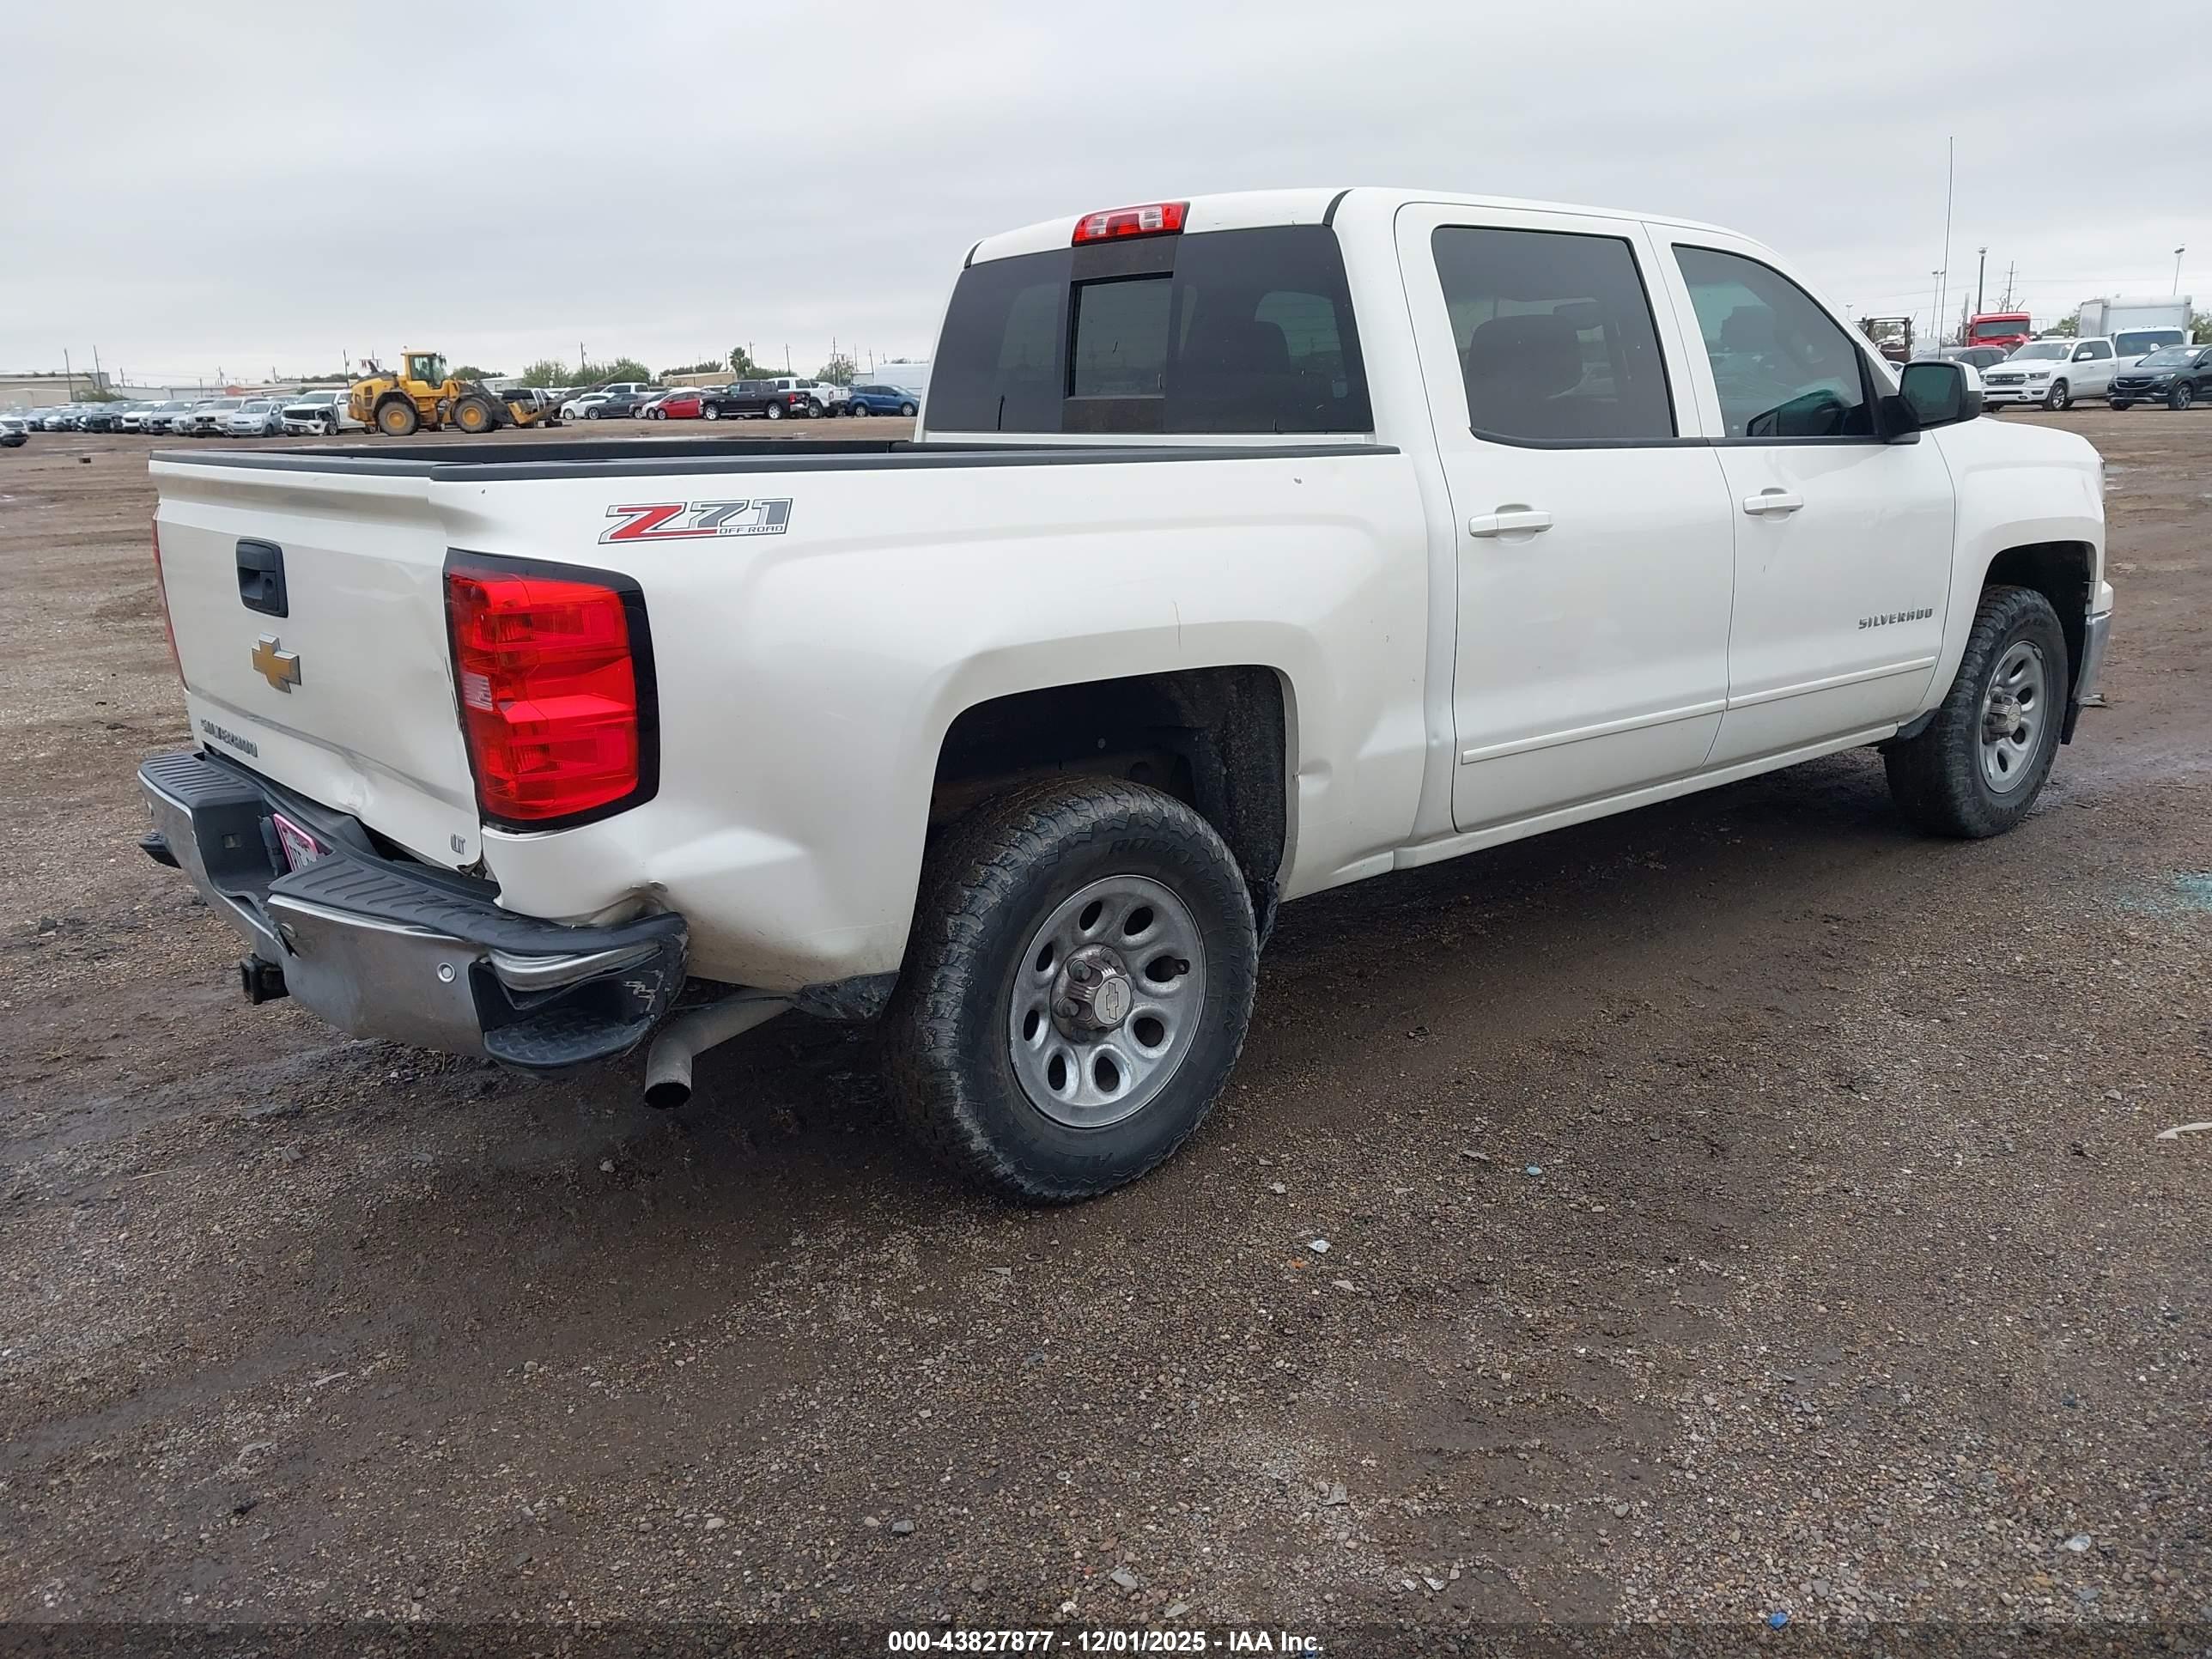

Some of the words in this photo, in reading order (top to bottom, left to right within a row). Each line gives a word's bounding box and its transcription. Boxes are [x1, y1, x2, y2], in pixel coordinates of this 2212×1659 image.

[598, 497, 793, 544] Z71
[719, 526, 744, 535] OFF
[748, 525, 784, 533] ROAD
[1857, 608, 1935, 630] SILVERADO
